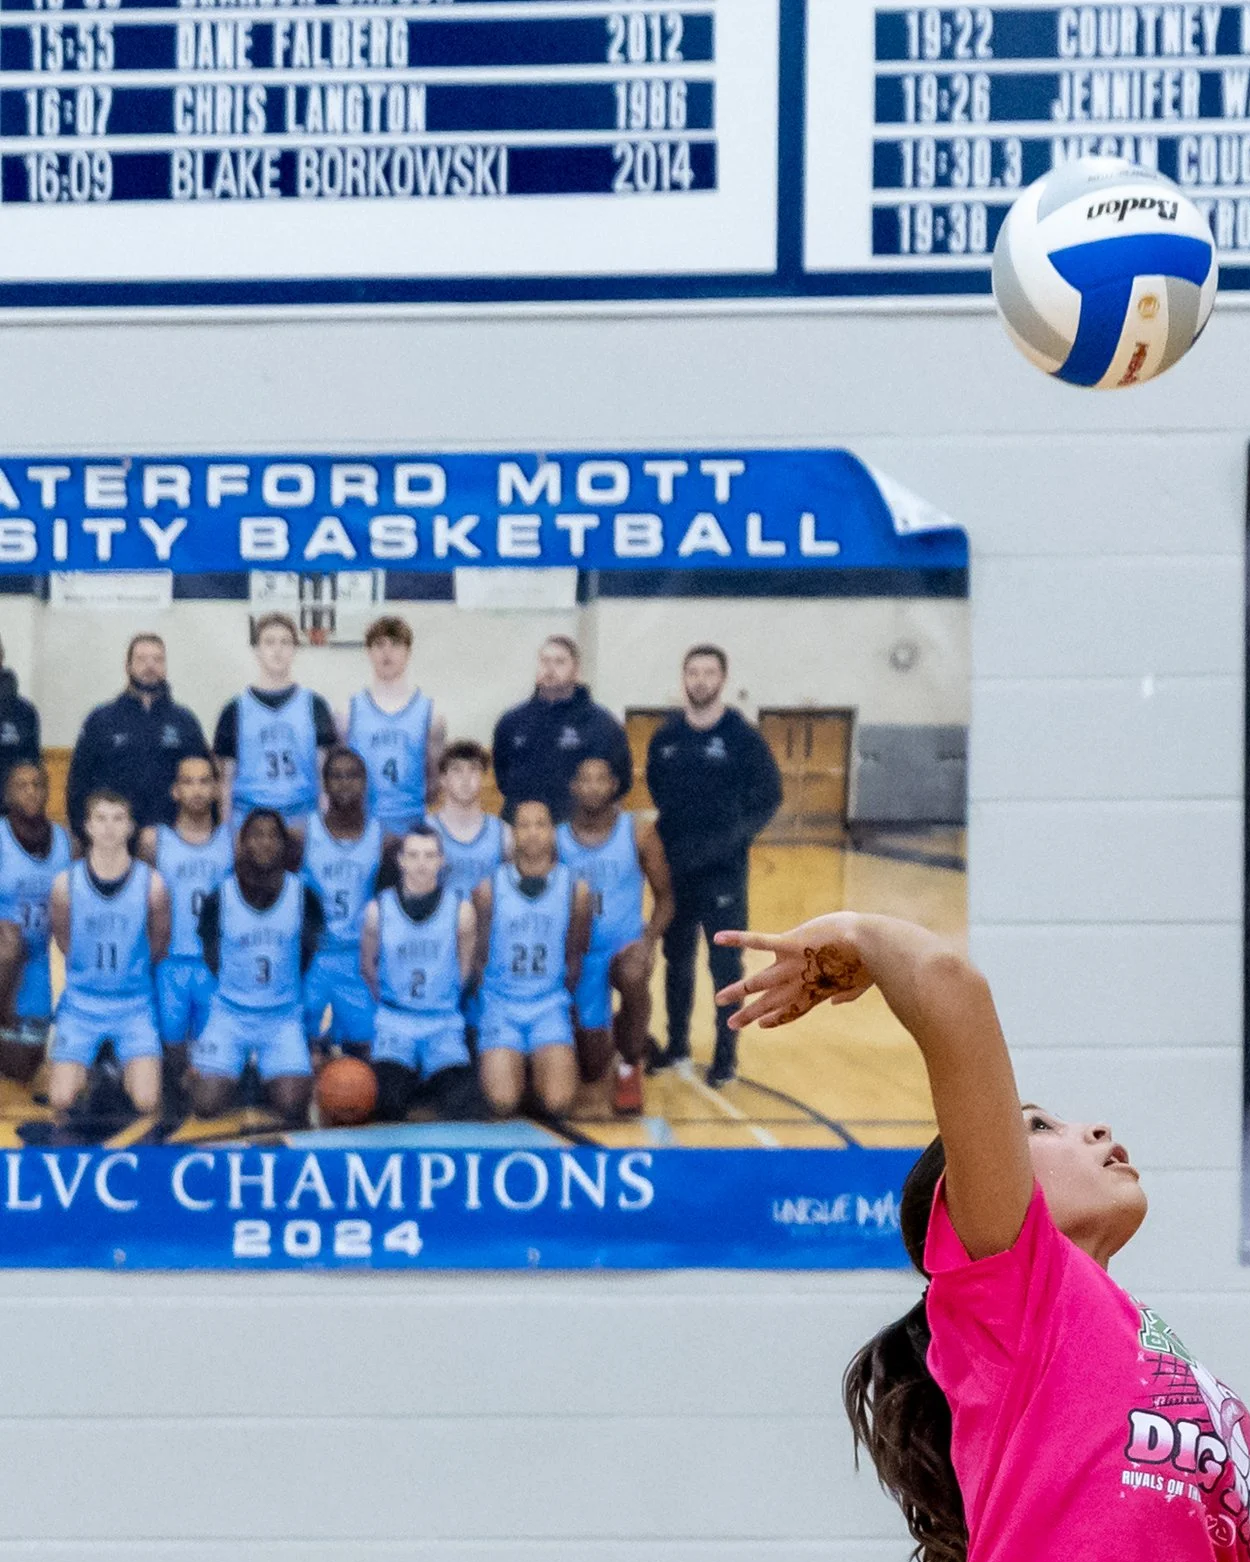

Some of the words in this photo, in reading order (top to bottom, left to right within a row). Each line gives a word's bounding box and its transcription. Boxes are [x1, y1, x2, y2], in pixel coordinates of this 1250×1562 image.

[31, 19, 115, 70] 15:55
[176, 19, 253, 70] DANE
[272, 17, 408, 68] FALBERG
[607, 11, 684, 64] 2012
[907, 7, 993, 60] 19:22
[1057, 5, 1222, 58] COURTNEY
[27, 85, 113, 136] 16:07
[173, 84, 267, 134] CHRIS
[285, 81, 427, 133] LANGTON
[904, 71, 992, 123] 19:26
[1052, 69, 1200, 122] JENNIFER
[26, 150, 114, 201] 16:09
[172, 148, 282, 199] BLAKE
[297, 143, 508, 198] BORKOWSKI
[613, 140, 695, 193] 2014
[1086, 197, 1179, 222] Baden
[498, 458, 747, 505] MOTT
[238, 513, 843, 560] BASKETBALL
[381, 757, 399, 785] 4
[511, 942, 549, 978] 22
[6, 1152, 139, 1212] LVC
[170, 1150, 656, 1212] CHAMPIONS
[232, 1218, 424, 1260] 2024
[1124, 1408, 1230, 1494] DIG
[1121, 1470, 1164, 1491] RIVALS
[1167, 1479, 1184, 1496] ON
